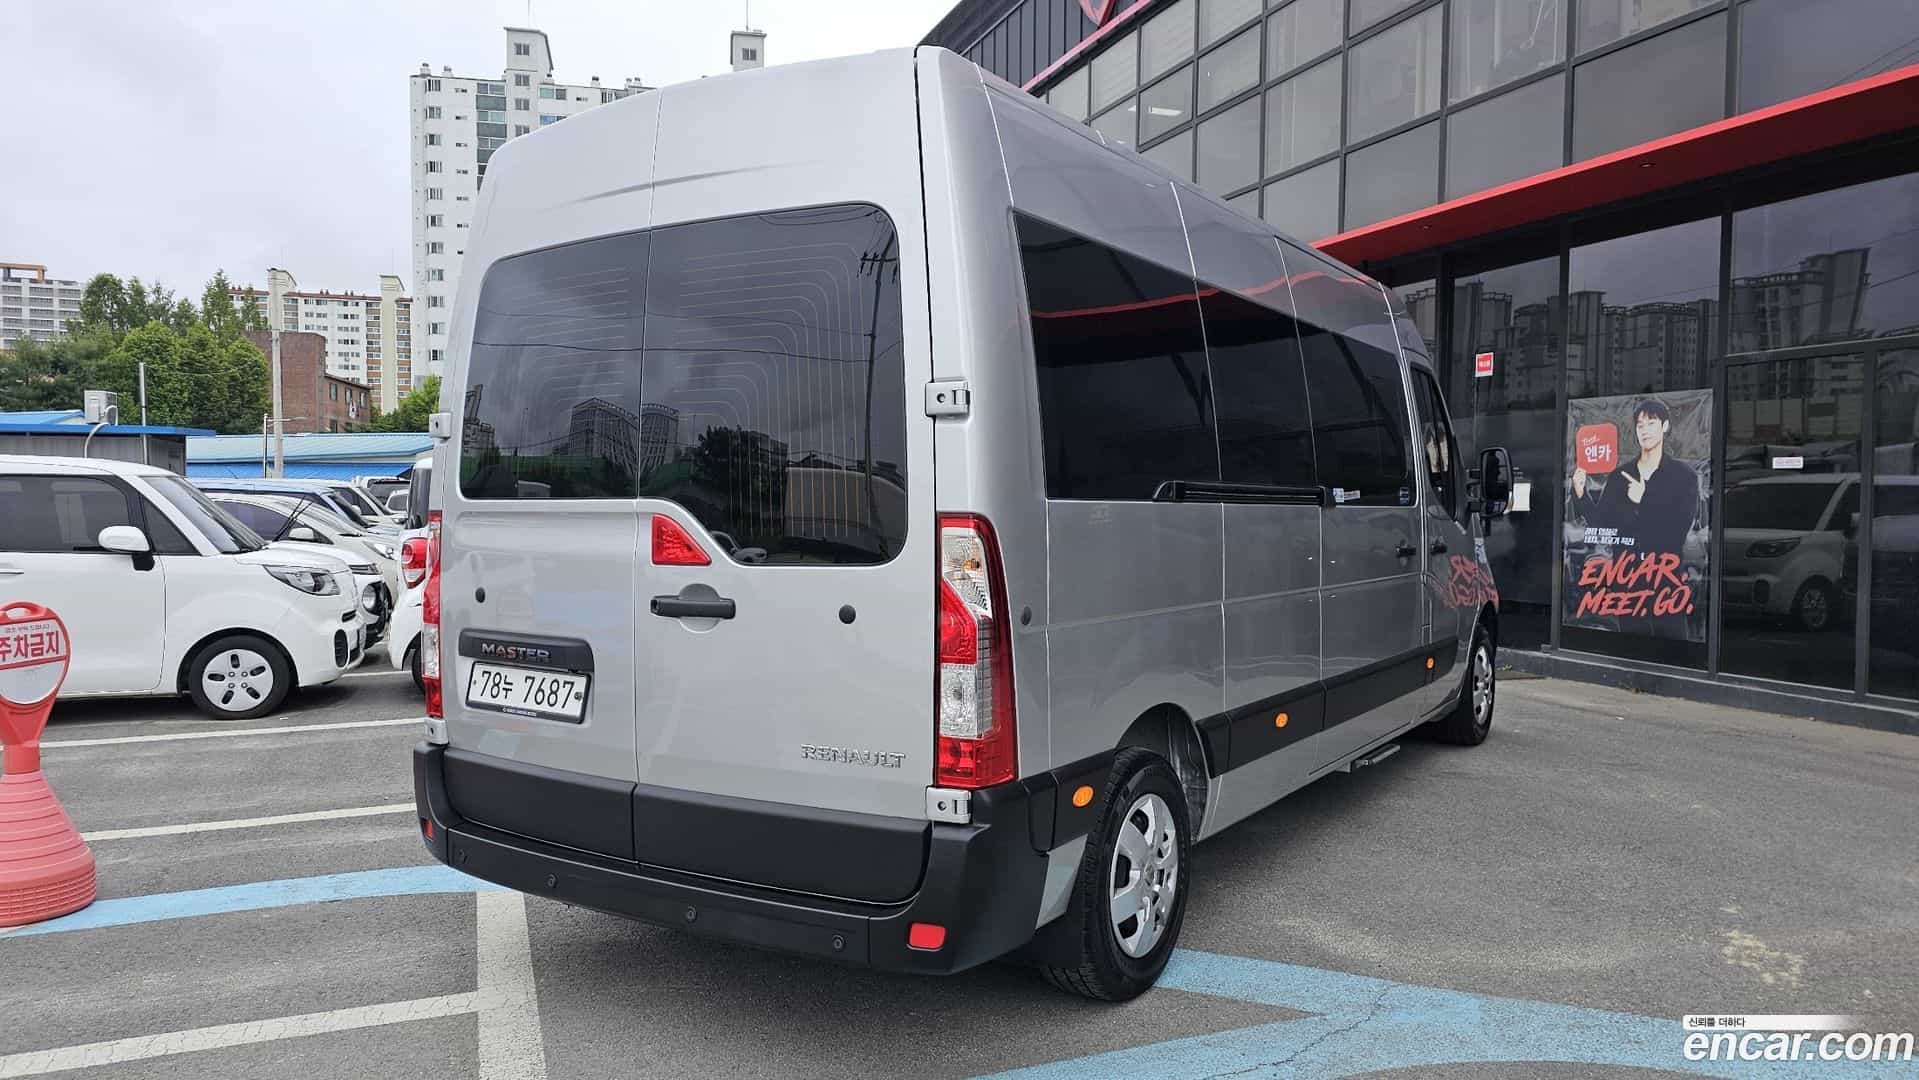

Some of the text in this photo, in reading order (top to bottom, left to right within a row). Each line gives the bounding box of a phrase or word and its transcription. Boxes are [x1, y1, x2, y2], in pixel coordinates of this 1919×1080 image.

[1585, 444, 1612, 462] 엔카
[1579, 550, 1689, 589] ENCAR.
[1576, 585, 1693, 618] MEET. GO.
[0, 630, 60, 662] 주차금지
[481, 643, 551, 662] MASTER
[480, 670, 575, 709] 78누 7687
[800, 743, 907, 769] RENAULT
